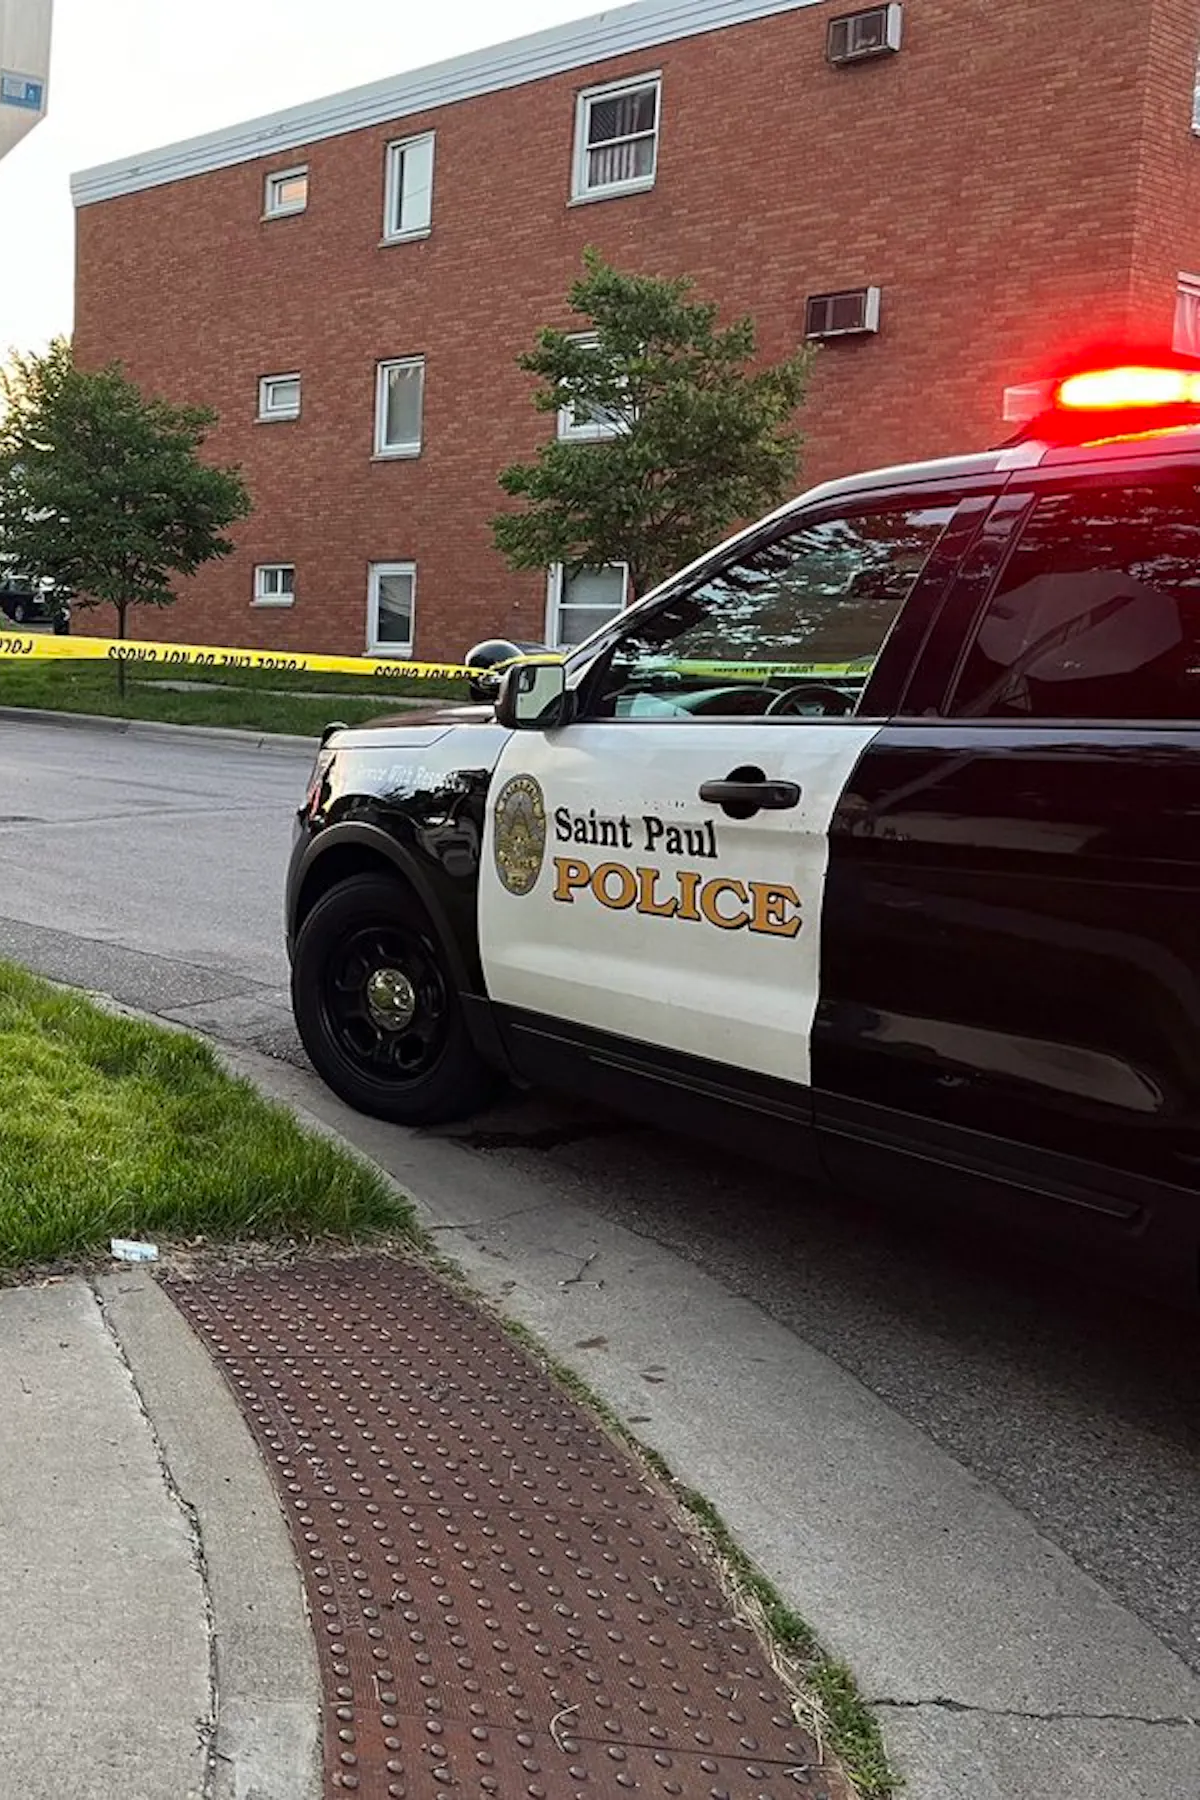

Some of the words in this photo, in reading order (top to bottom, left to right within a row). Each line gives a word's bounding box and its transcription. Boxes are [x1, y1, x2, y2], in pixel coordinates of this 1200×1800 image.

[554, 806, 632, 849] Saint
[642, 814, 718, 858] Paul
[552, 856, 803, 938] POLICE
